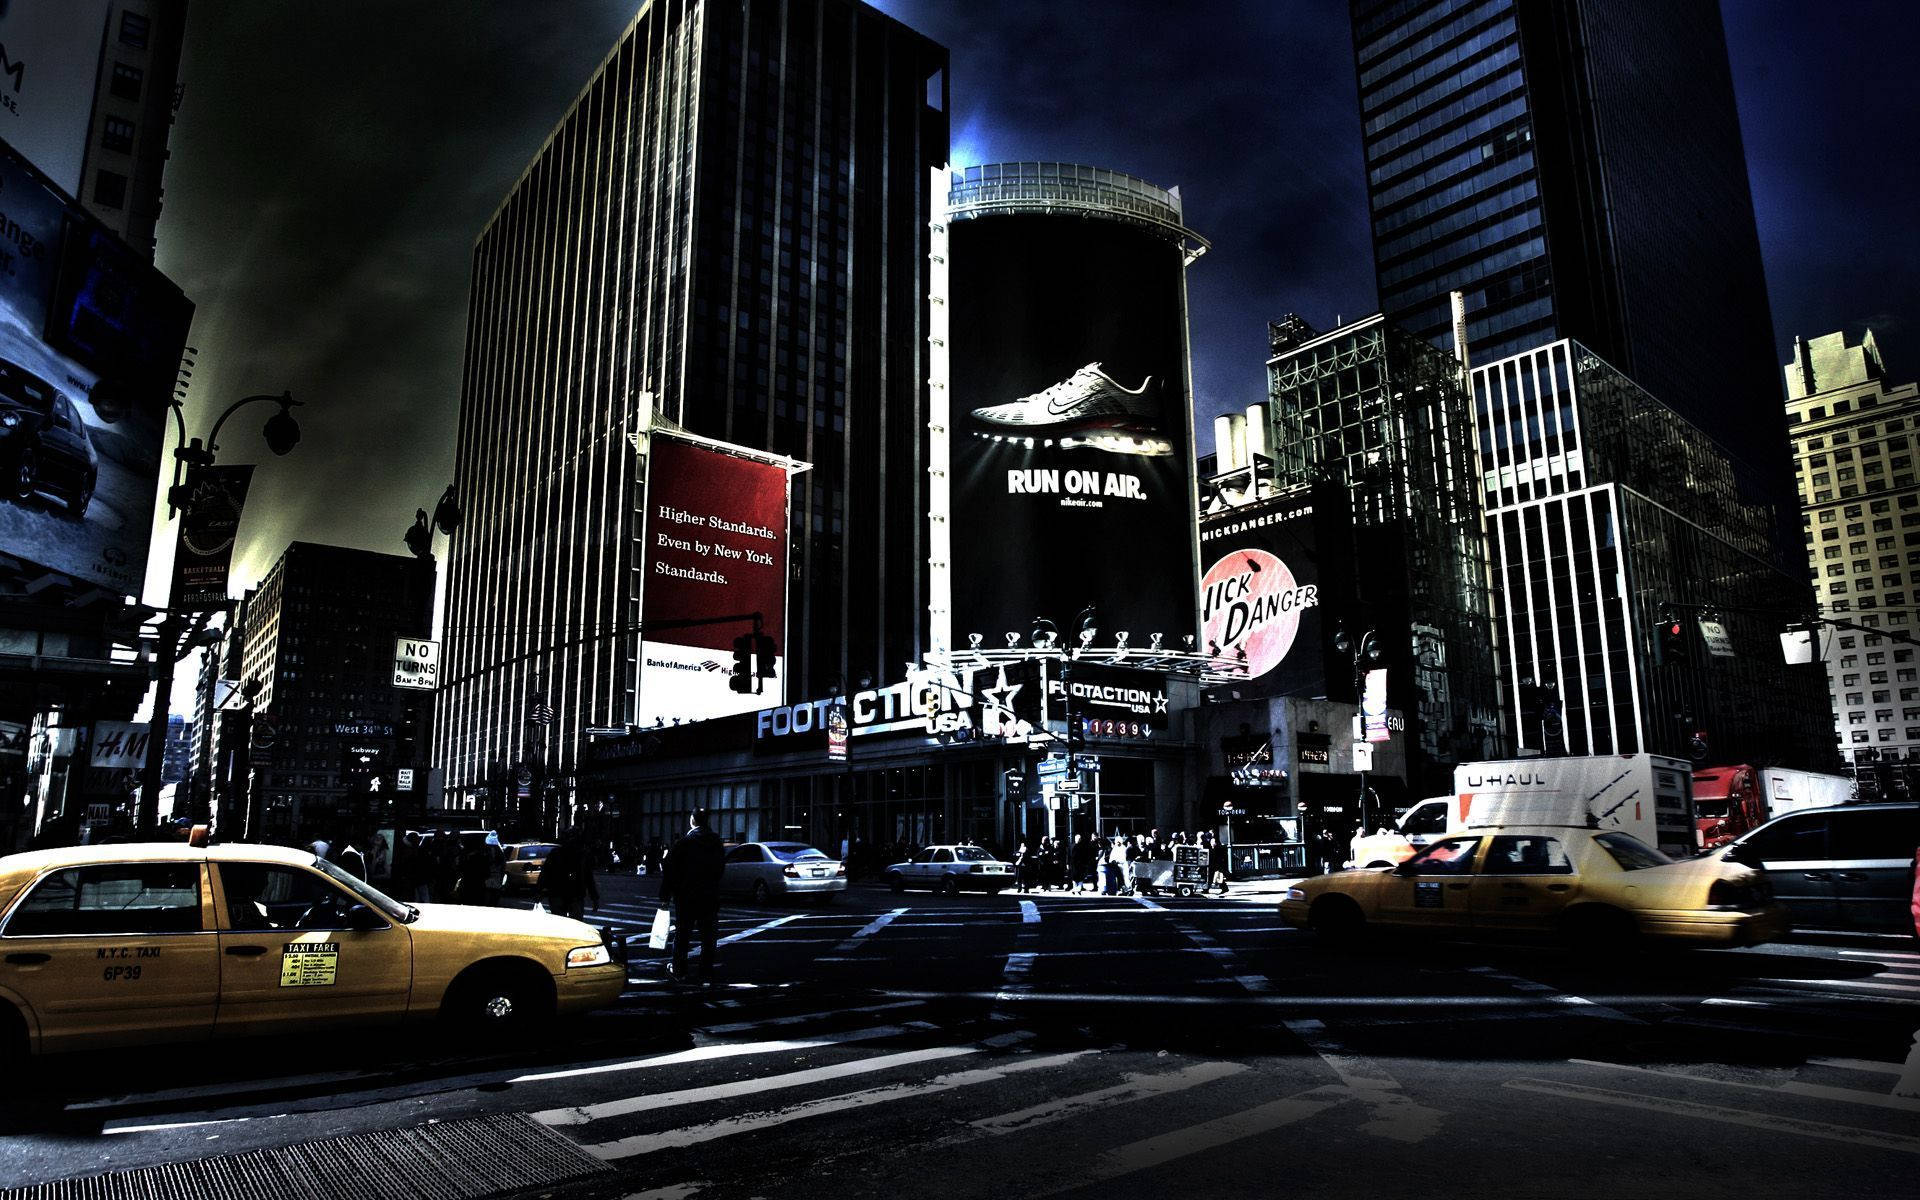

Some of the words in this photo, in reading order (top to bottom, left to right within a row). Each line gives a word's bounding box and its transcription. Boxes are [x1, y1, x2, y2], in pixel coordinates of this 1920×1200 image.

[1007, 469, 1060, 493] RUN
[1064, 470, 1100, 495] ON
[1104, 472, 1148, 501] AIR.
[1060, 498, 1103, 508] nikeair.com
[659, 505, 706, 526] Higher
[708, 516, 777, 540] Standards.
[1201, 506, 1313, 542] NICKDANGER.com
[657, 533, 691, 551] Even
[695, 540, 711, 556] by
[714, 543, 742, 560] New
[745, 549, 774, 566] York
[655, 561, 729, 585] Standards.
[1223, 586, 1319, 646] DANGER
[405, 643, 429, 658] NO
[396, 659, 436, 675] TURNS
[1131, 704, 1151, 714] USA
[335, 724, 359, 734] West
[925, 709, 973, 735] USA
[95, 731, 151, 759] H&M
[351, 747, 380, 755] Subway
[97, 947, 132, 959] N.Y.C.
[136, 946, 161, 958] TAXI
[289, 944, 310, 952] TAXI
[313, 943, 335, 951] FARE
[104, 965, 142, 981] 6P39
